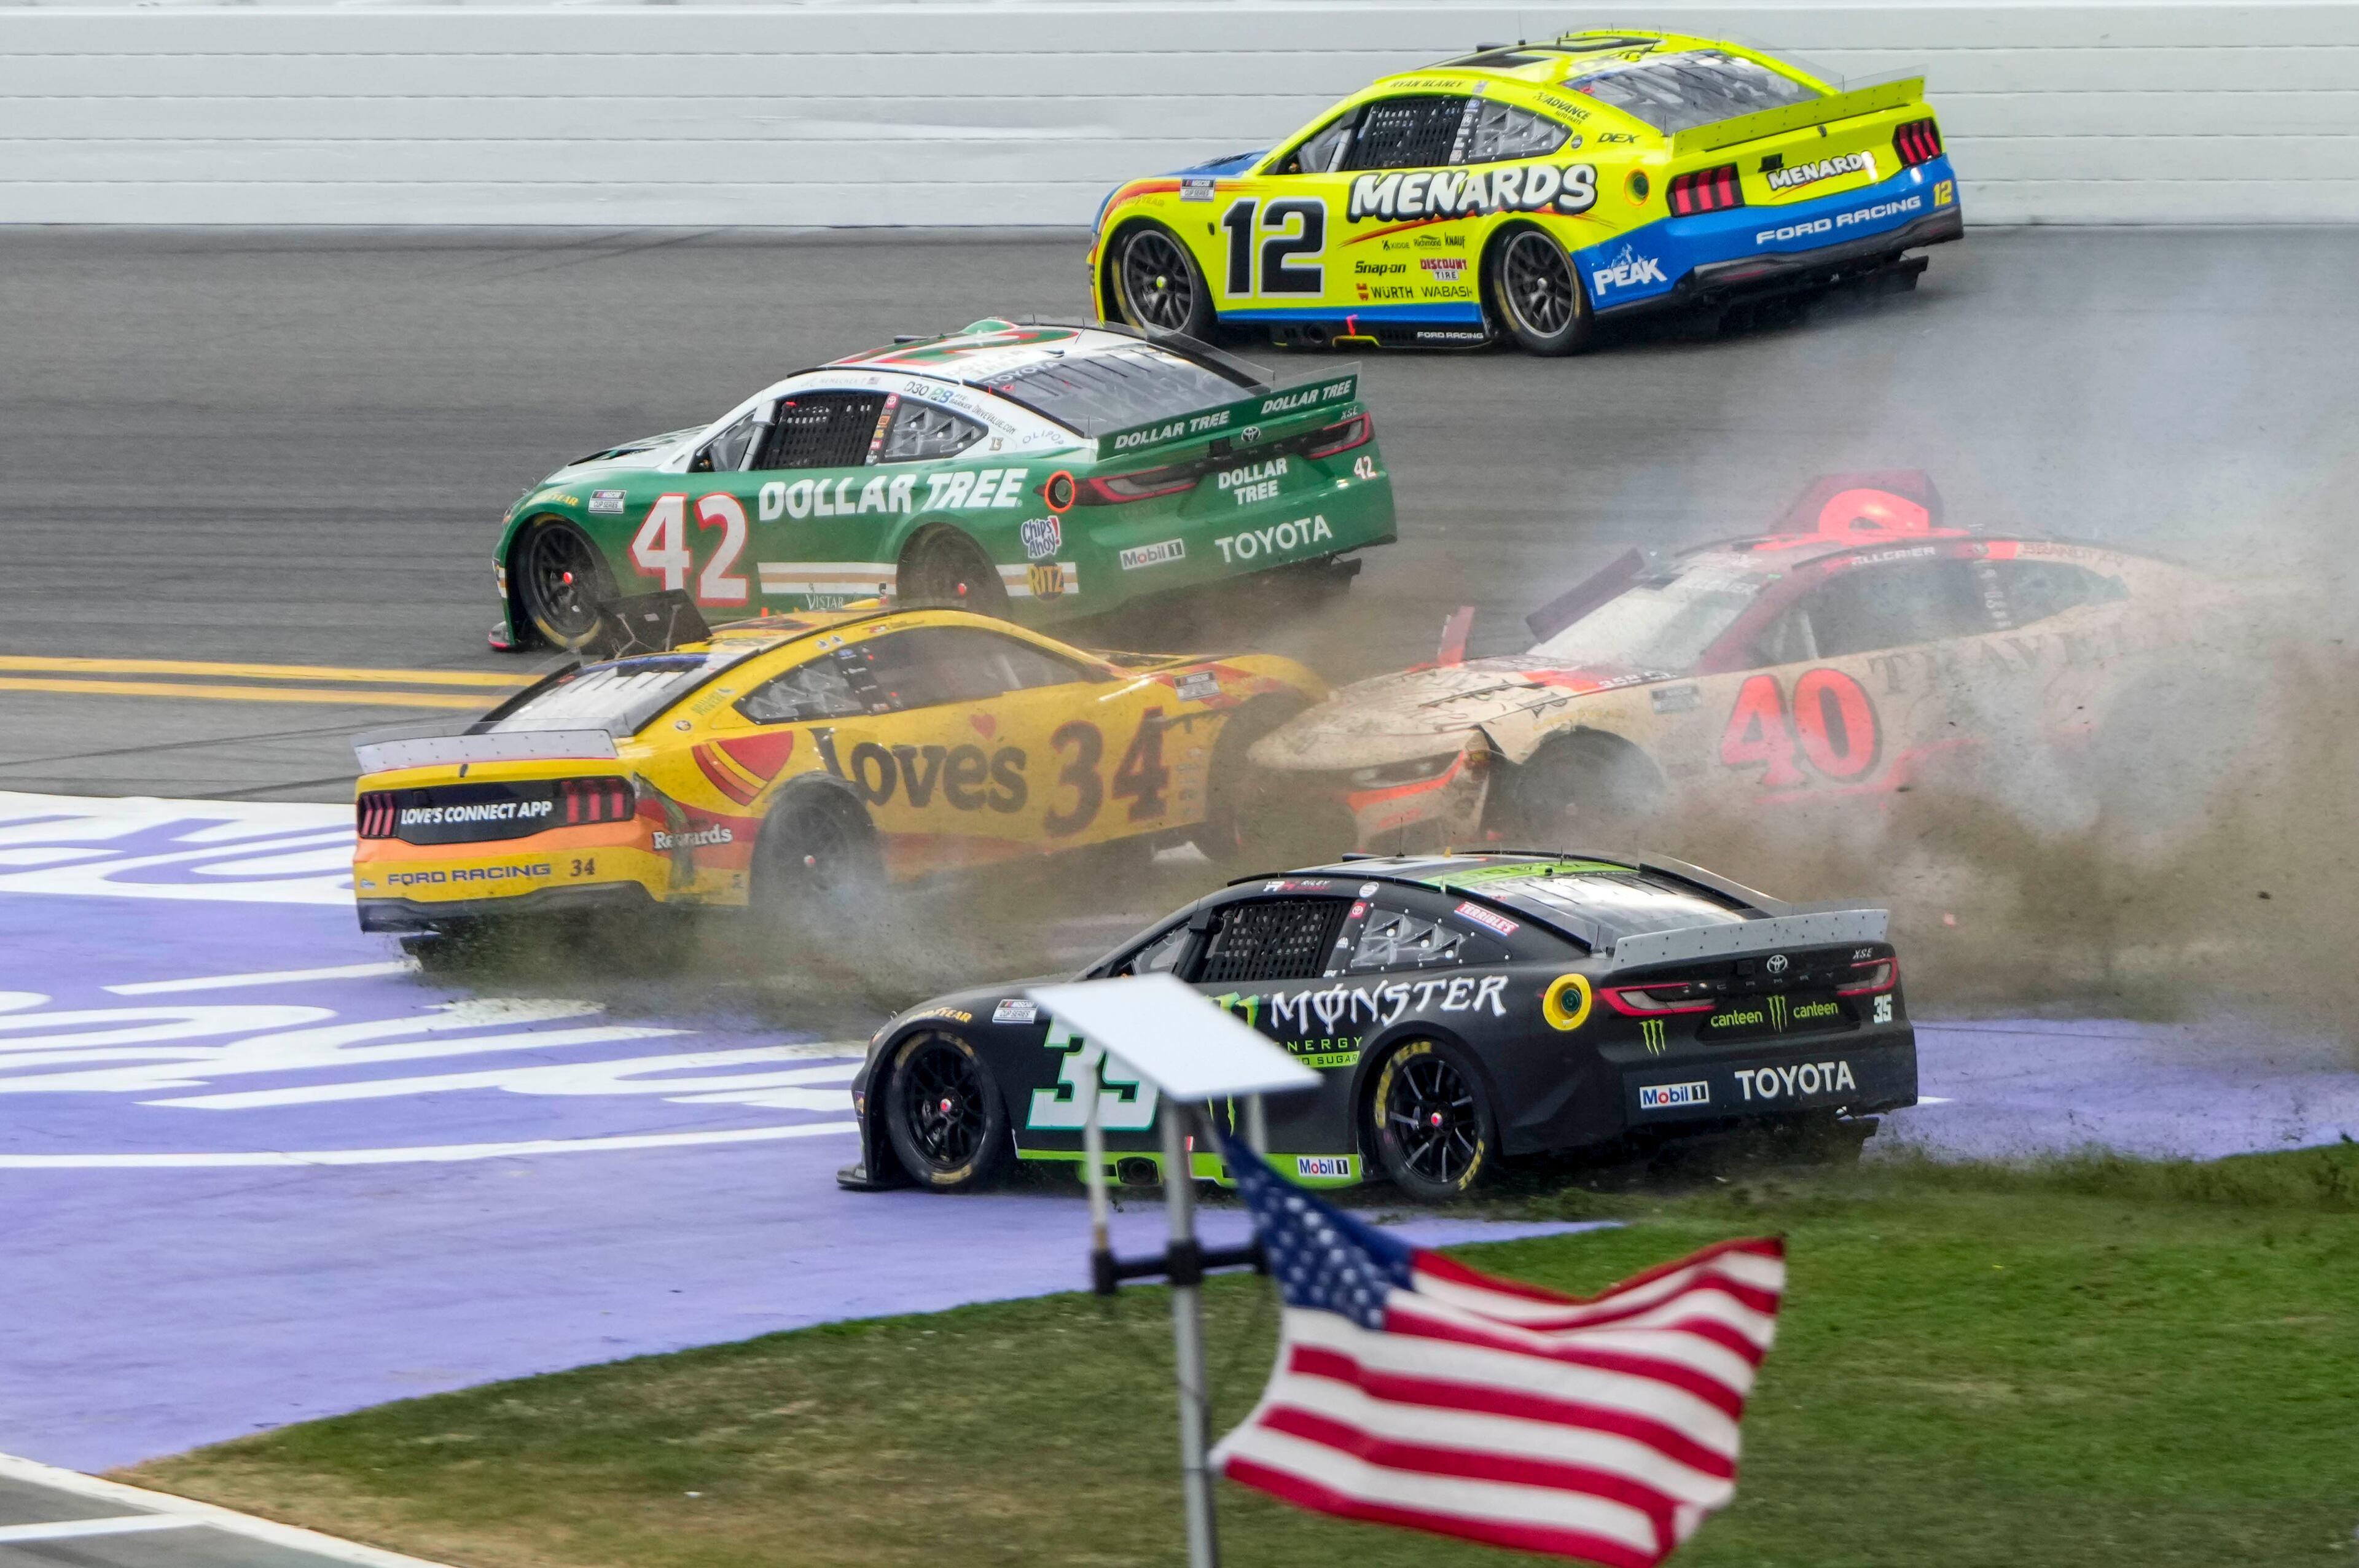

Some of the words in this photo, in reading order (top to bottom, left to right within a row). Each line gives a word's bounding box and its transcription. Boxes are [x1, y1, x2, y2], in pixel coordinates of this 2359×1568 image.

[1544, 96, 1592, 120] ADVANCE
[1347, 164, 1597, 224] MENARDS
[1933, 180, 1953, 207] 12
[1756, 218, 1832, 244] FORD
[1836, 195, 1921, 228] RACING
[1222, 197, 1327, 299] 12
[1355, 260, 1406, 276] Snap-on
[1420, 259, 1467, 270] DISCOUNT
[1593, 257, 1667, 295] PEAK
[1261, 388, 1318, 415] DOLLAR
[1322, 380, 1352, 401] TREE
[1022, 430, 1065, 445] OLIPOP
[1114, 421, 1185, 449] DOLLAR
[1189, 410, 1230, 432] TREE
[1218, 458, 1288, 490] DOLLAR
[1353, 456, 1376, 479] 42
[759, 474, 917, 521] DOLLAR
[921, 468, 1029, 510] TREE
[1234, 480, 1279, 505] TREE
[1022, 520, 1053, 544] Chips
[1215, 515, 1333, 563] TOYOTA
[627, 491, 751, 607] 42
[1123, 545, 1166, 567] Mobil
[1028, 564, 1065, 596] RITZ
[1723, 668, 1881, 786] 40
[1043, 706, 1170, 840] 34
[401, 806, 443, 825] LOVE'S
[445, 803, 515, 823] CONNECT
[517, 800, 553, 819] APP
[388, 870, 447, 886] FORD
[452, 863, 551, 883] RACING
[569, 857, 595, 878] 34
[1853, 947, 1873, 959] XSE
[1710, 1010, 1764, 1028] canteen
[1793, 1001, 1839, 1018] canteen
[1873, 994, 1892, 1024] 35
[1269, 1036, 1363, 1052] NERGY
[1316, 1054, 1358, 1065] SUGAR
[1734, 1061, 1856, 1101] TOYOTA
[1643, 1084, 1689, 1105] Mobil
[1299, 1157, 1335, 1175] Mobil
